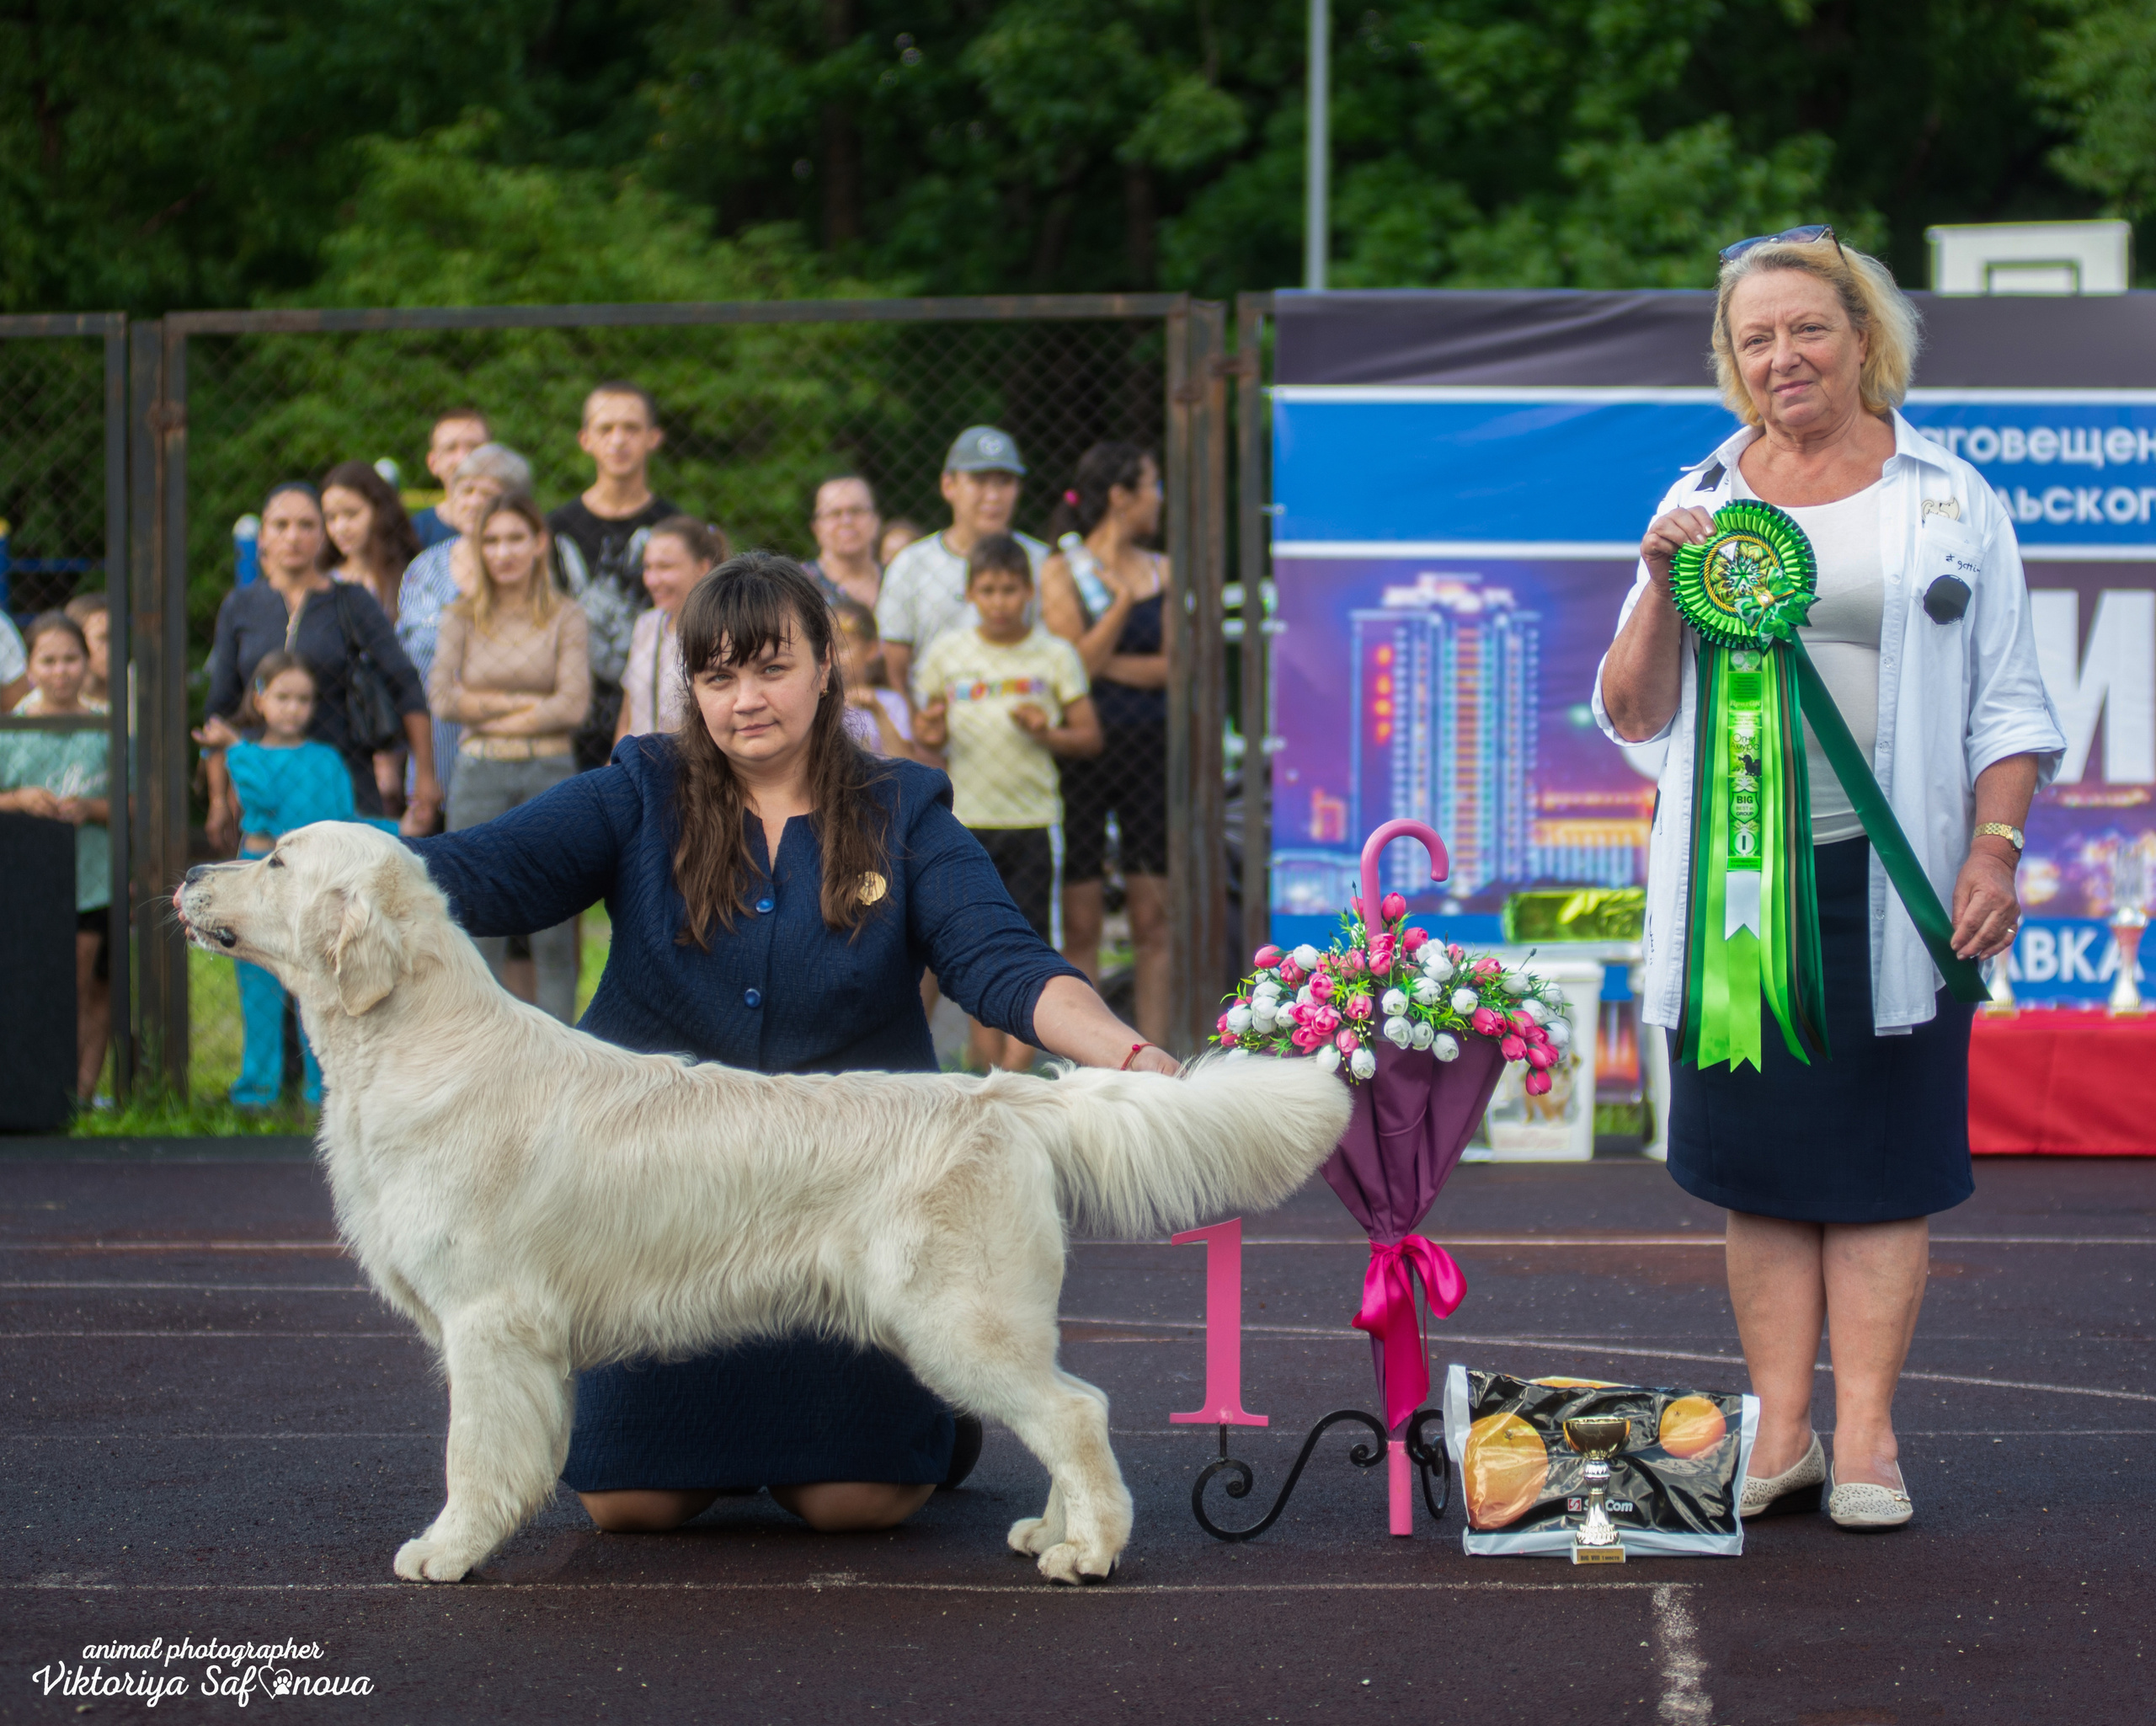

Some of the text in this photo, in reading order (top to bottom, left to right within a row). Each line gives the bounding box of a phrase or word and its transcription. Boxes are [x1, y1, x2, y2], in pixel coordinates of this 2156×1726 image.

[1730, 742, 1760, 751] Амура
[1732, 733, 1756, 742] Огни
[2008, 926, 2145, 982] ВКА
[1169, 1217, 1268, 1426] 1
